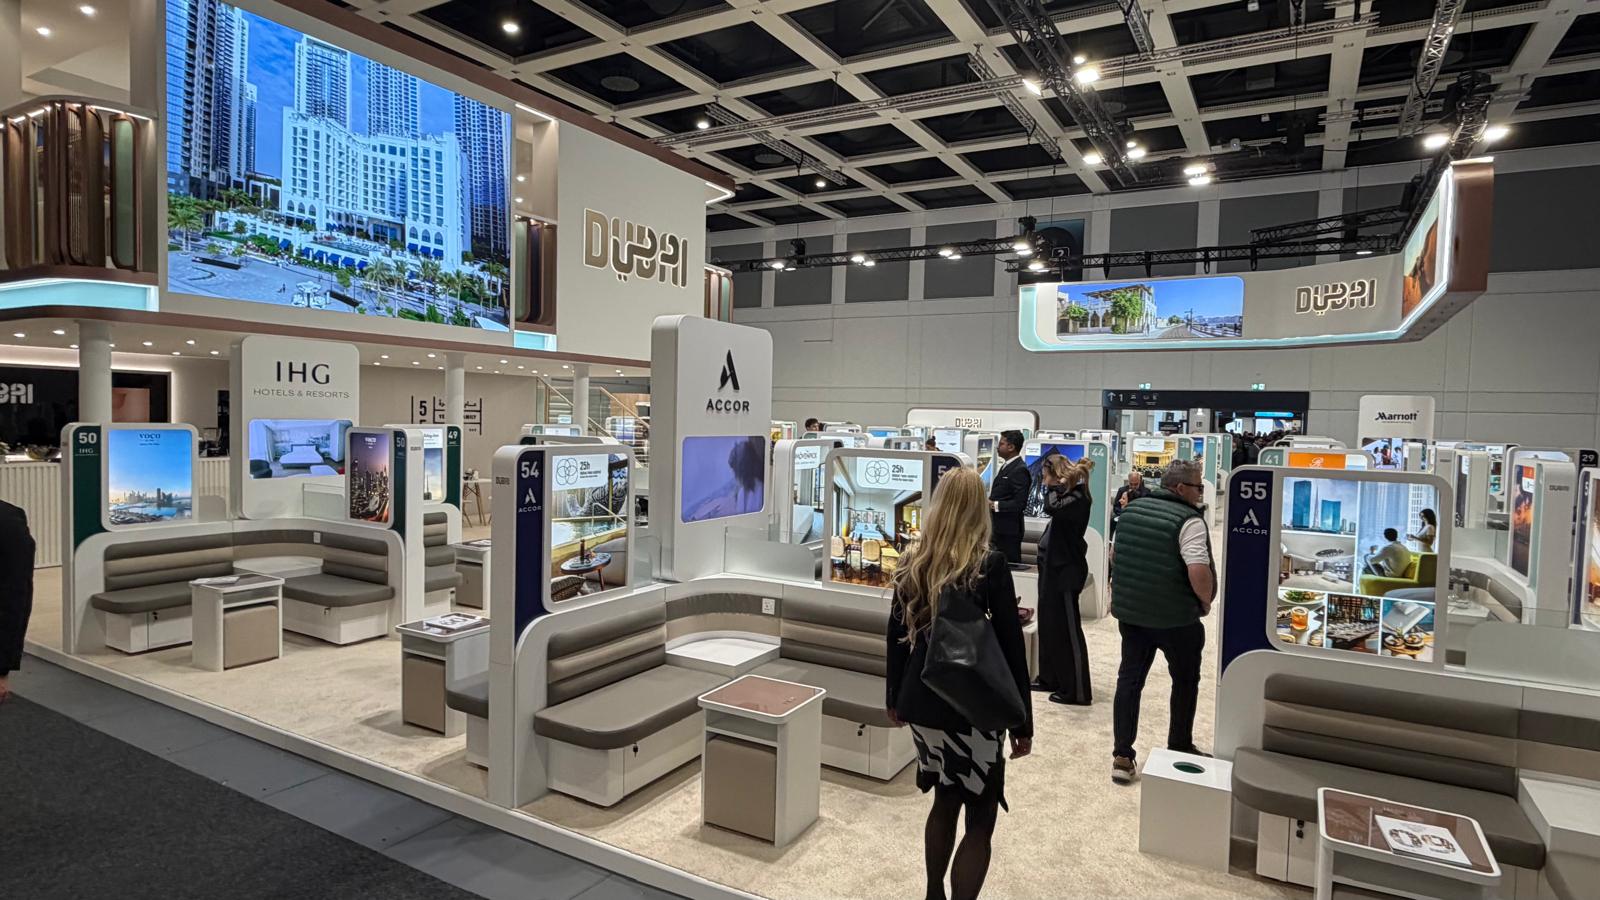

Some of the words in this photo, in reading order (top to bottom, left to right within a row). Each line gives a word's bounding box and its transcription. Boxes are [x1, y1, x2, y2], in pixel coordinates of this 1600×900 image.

[584, 208, 688, 288] DUBAI
[1295, 278, 1377, 316] DUBAI
[276, 361, 330, 385] IHG
[253, 388, 295, 397] HOTELS
[297, 389, 303, 397] &
[305, 390, 350, 399] RESORTS
[706, 398, 750, 412] ACCOR
[1375, 411, 1420, 421] Marriott
[79, 432, 98, 444] 50
[447, 430, 458, 440] 49
[1091, 447, 1105, 457] 44
[1264, 454, 1279, 465] 41
[1581, 454, 1595, 462] 29
[521, 461, 540, 479] 54
[891, 464, 904, 474] 25h
[1240, 481, 1267, 500] 55
[518, 505, 542, 513] ACCOR
[1232, 527, 1268, 536] ACCOR
